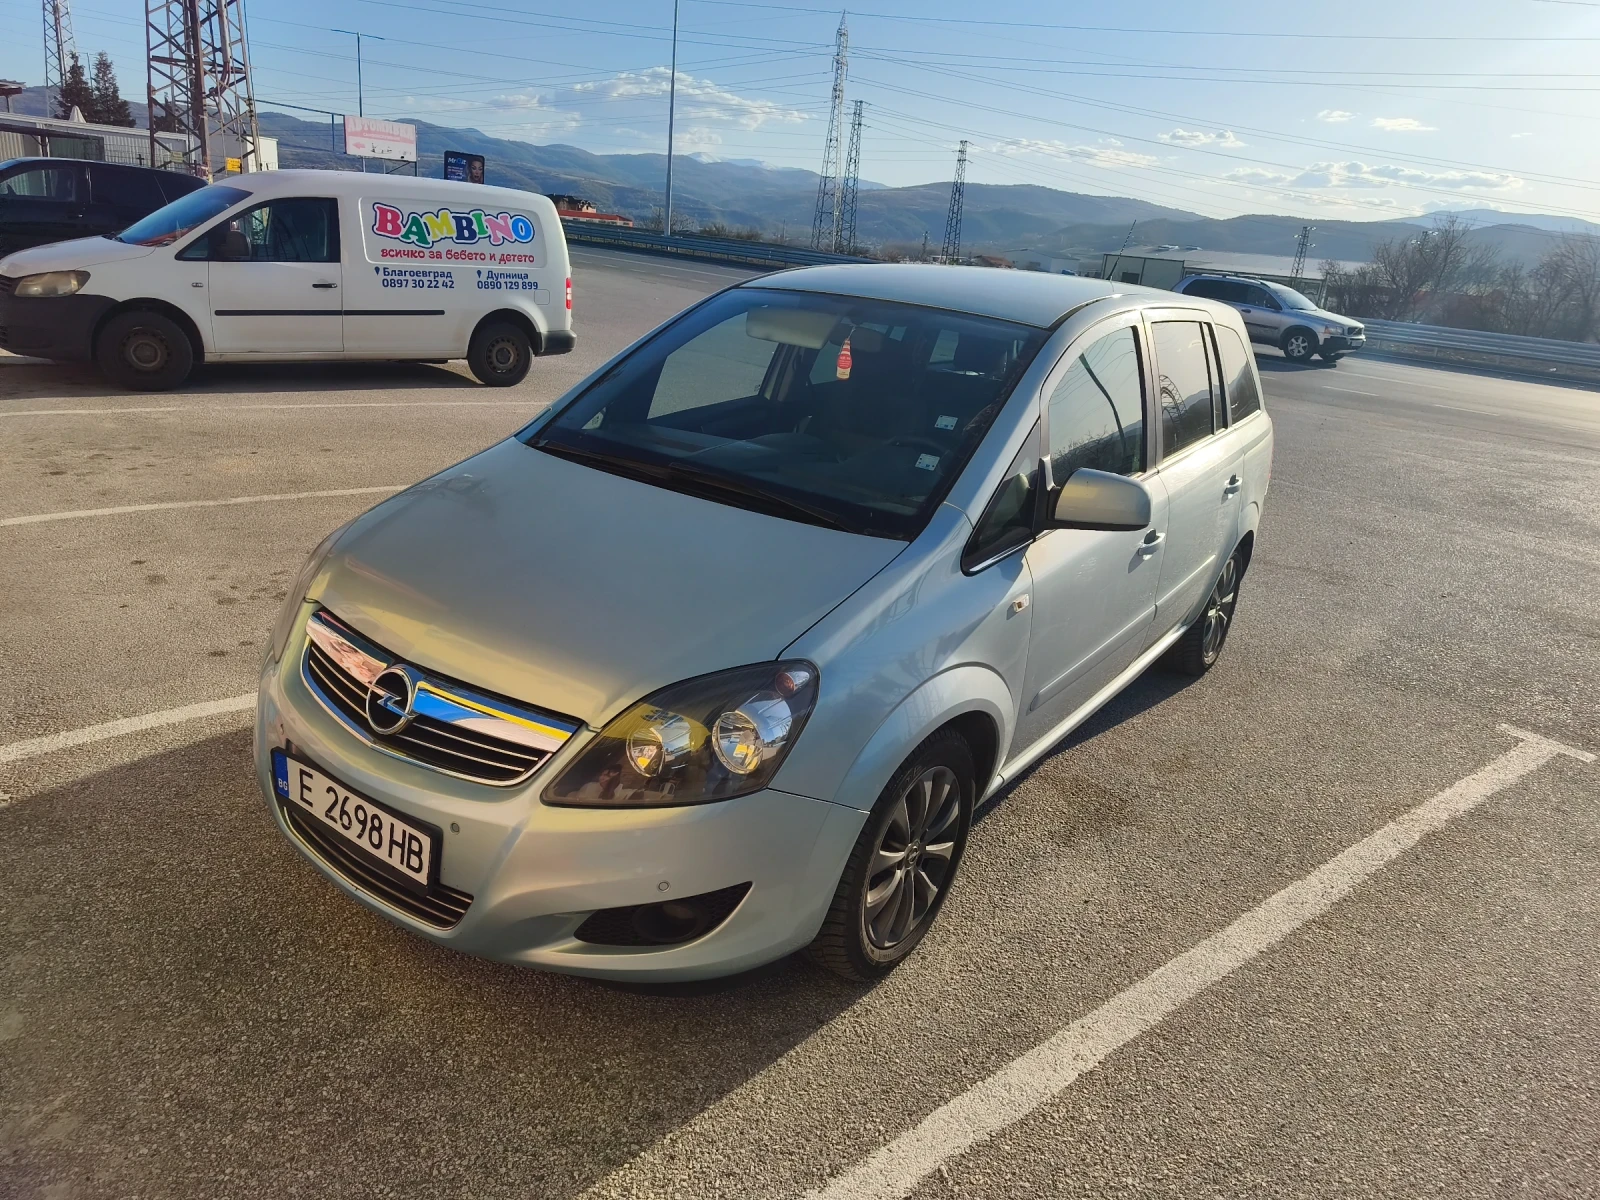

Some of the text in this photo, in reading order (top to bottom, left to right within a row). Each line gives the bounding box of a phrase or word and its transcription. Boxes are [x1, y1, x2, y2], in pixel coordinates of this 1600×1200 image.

[372, 203, 535, 248] BAMBINO
[380, 249, 535, 264] всичко за бебето и детето
[383, 267, 452, 279] Благоевград
[486, 270, 529, 281] Дупница
[382, 278, 455, 289] 0897 30 22 42
[477, 280, 538, 291] 0890 129 899
[278, 777, 288, 790] BG
[299, 767, 423, 873] E 2698 HB
